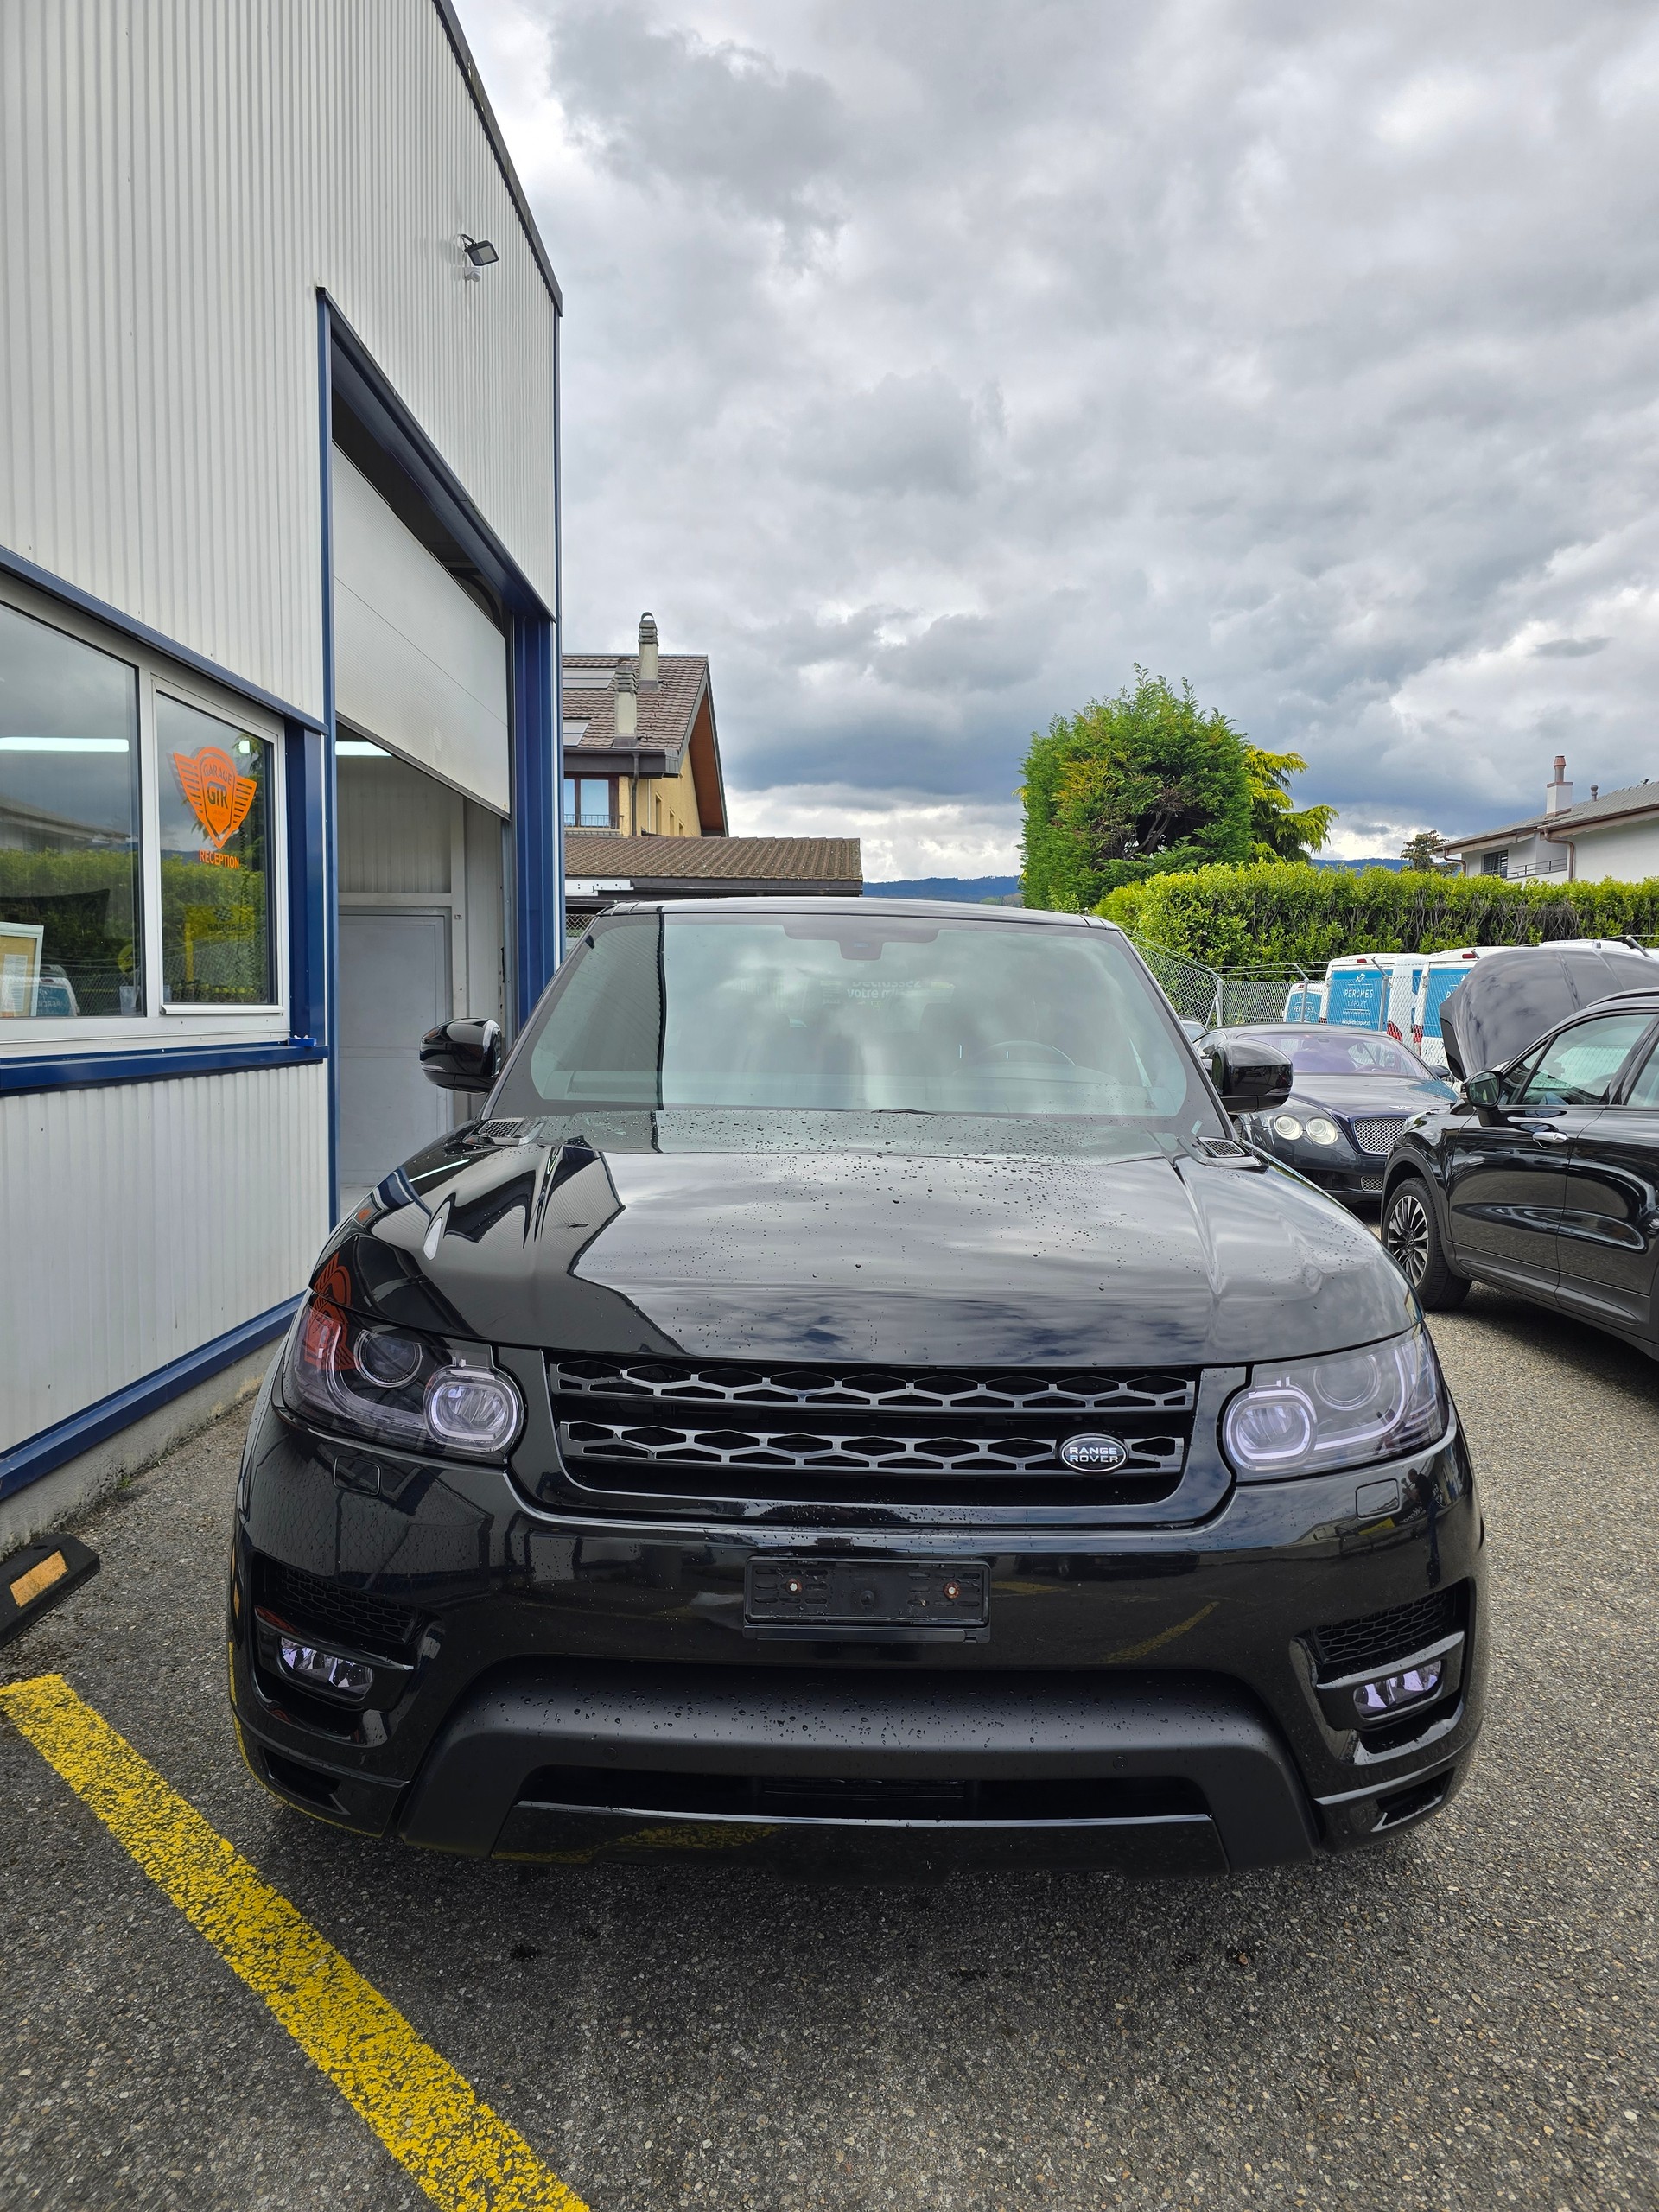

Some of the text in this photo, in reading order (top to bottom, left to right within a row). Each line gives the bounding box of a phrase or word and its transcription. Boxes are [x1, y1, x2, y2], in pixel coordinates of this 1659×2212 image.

[204, 764, 232, 786] GARAGE
[199, 850, 239, 870] RECEPTION
[847, 988, 879, 999] votre
[1344, 988, 1374, 999] PERCHES
